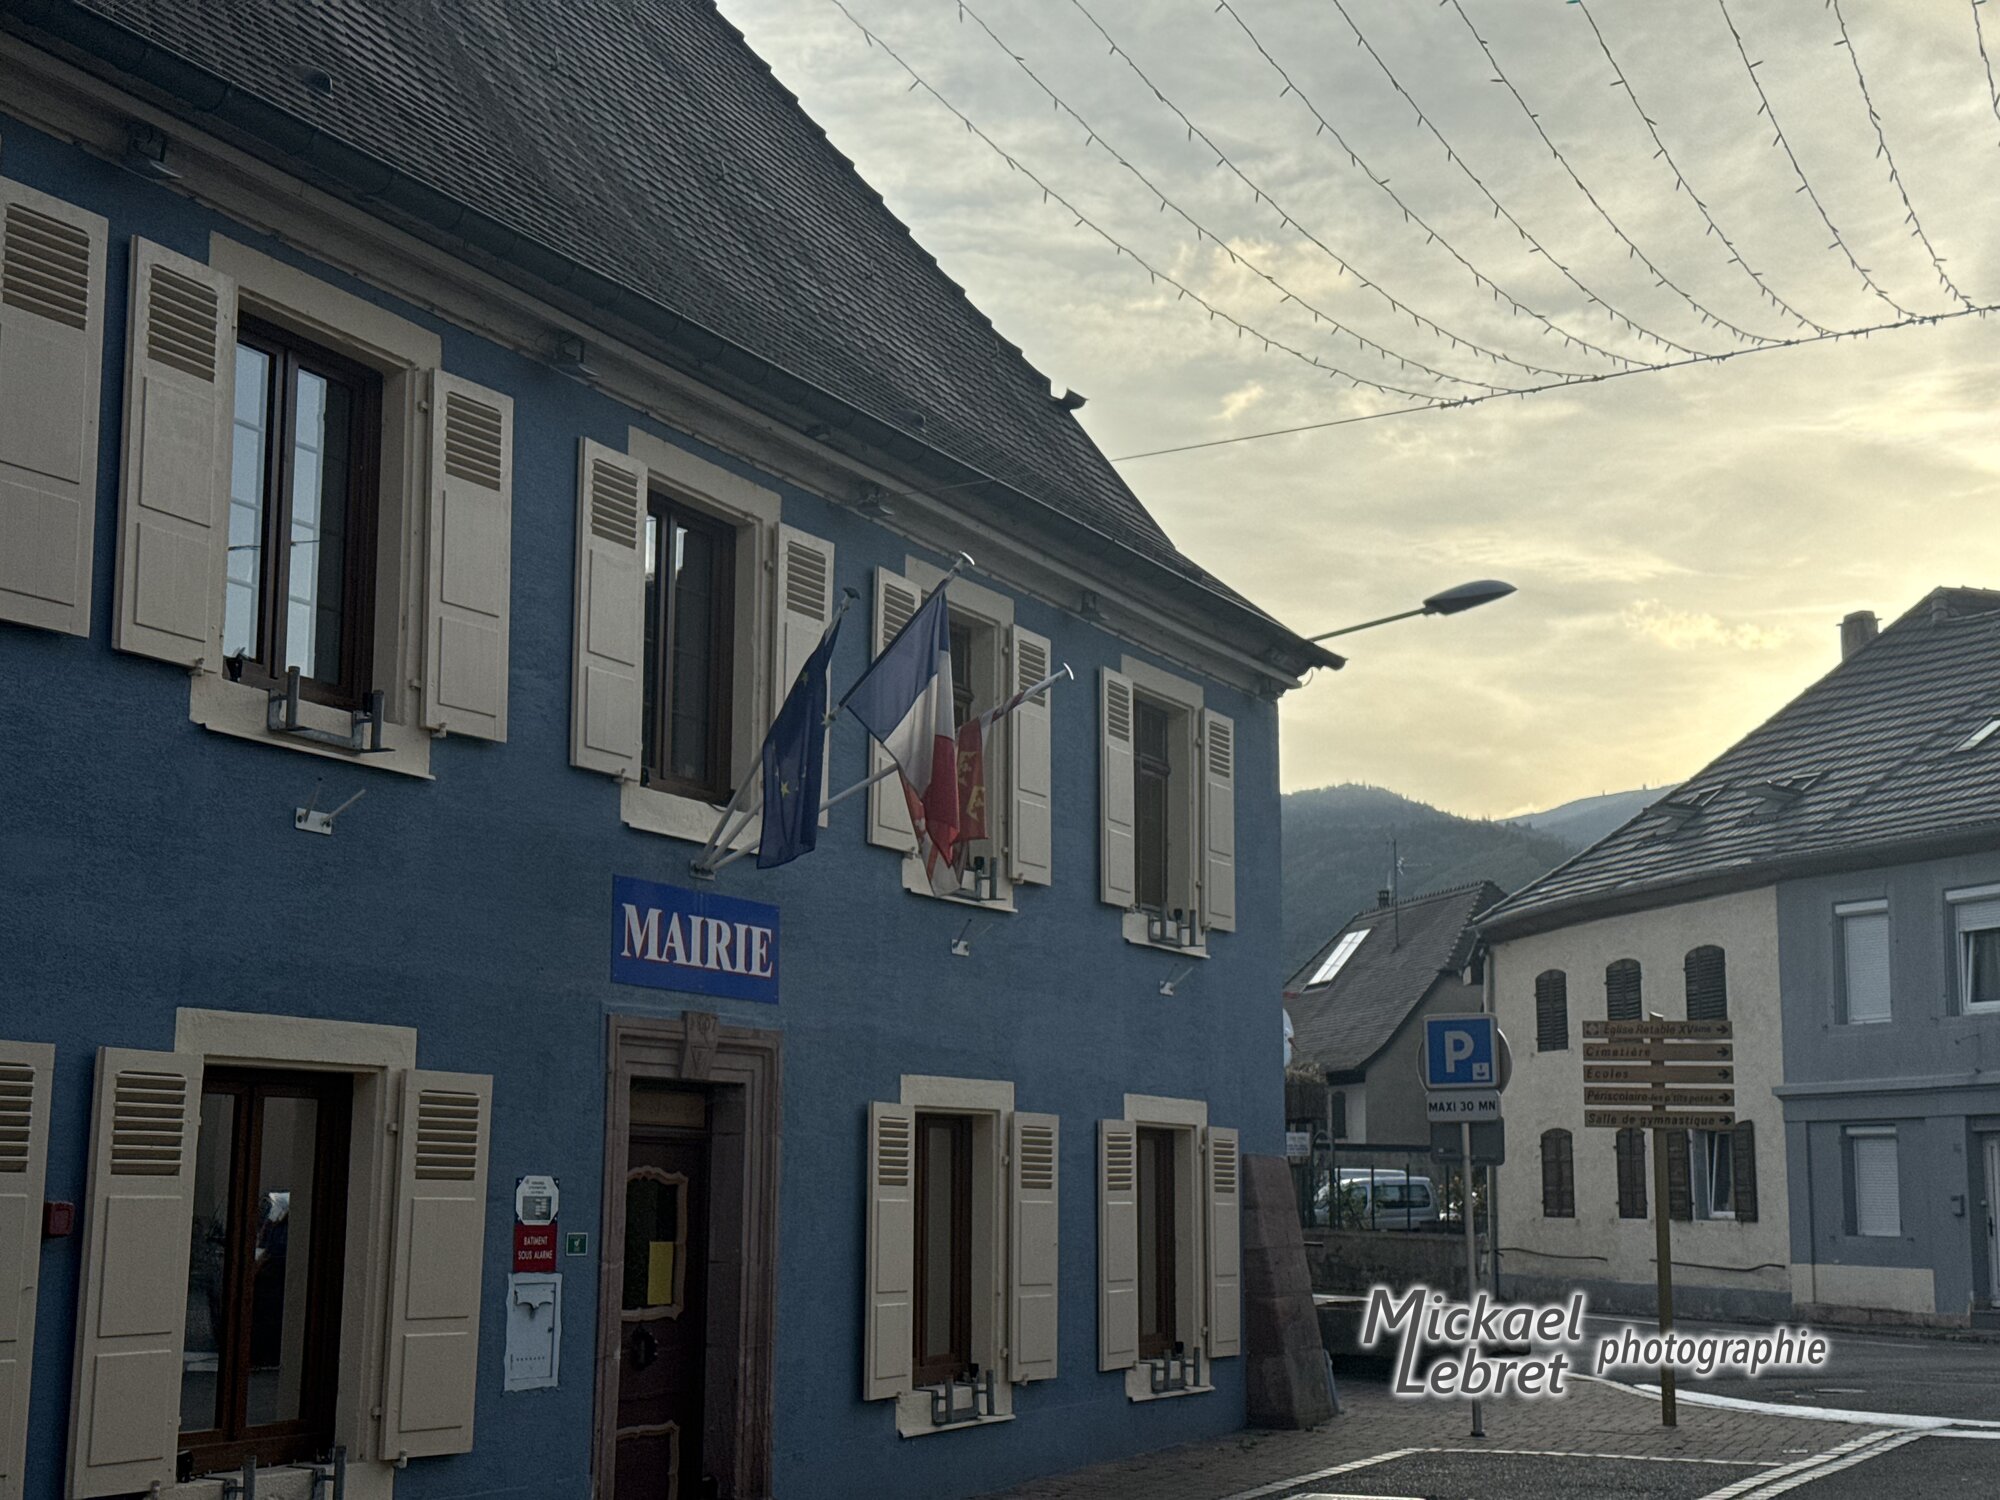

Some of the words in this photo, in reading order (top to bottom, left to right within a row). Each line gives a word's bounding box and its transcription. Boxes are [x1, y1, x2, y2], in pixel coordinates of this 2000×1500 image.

[620, 902, 773, 978] MAIRIE
[1635, 1023, 1676, 1035] Retable
[1444, 1030, 1475, 1073] P
[1586, 1045, 1651, 1057] Cimetière
[1428, 1101, 1456, 1112] MAXI
[1460, 1101, 1474, 1112] 30
[1478, 1100, 1496, 1111] MN
[1588, 1113, 1617, 1124] Salle
[1622, 1114, 1636, 1124] de
[1639, 1114, 1715, 1127] gymnastique
[518, 1250, 533, 1260] SOUS
[533, 1249, 553, 1260] ALARME
